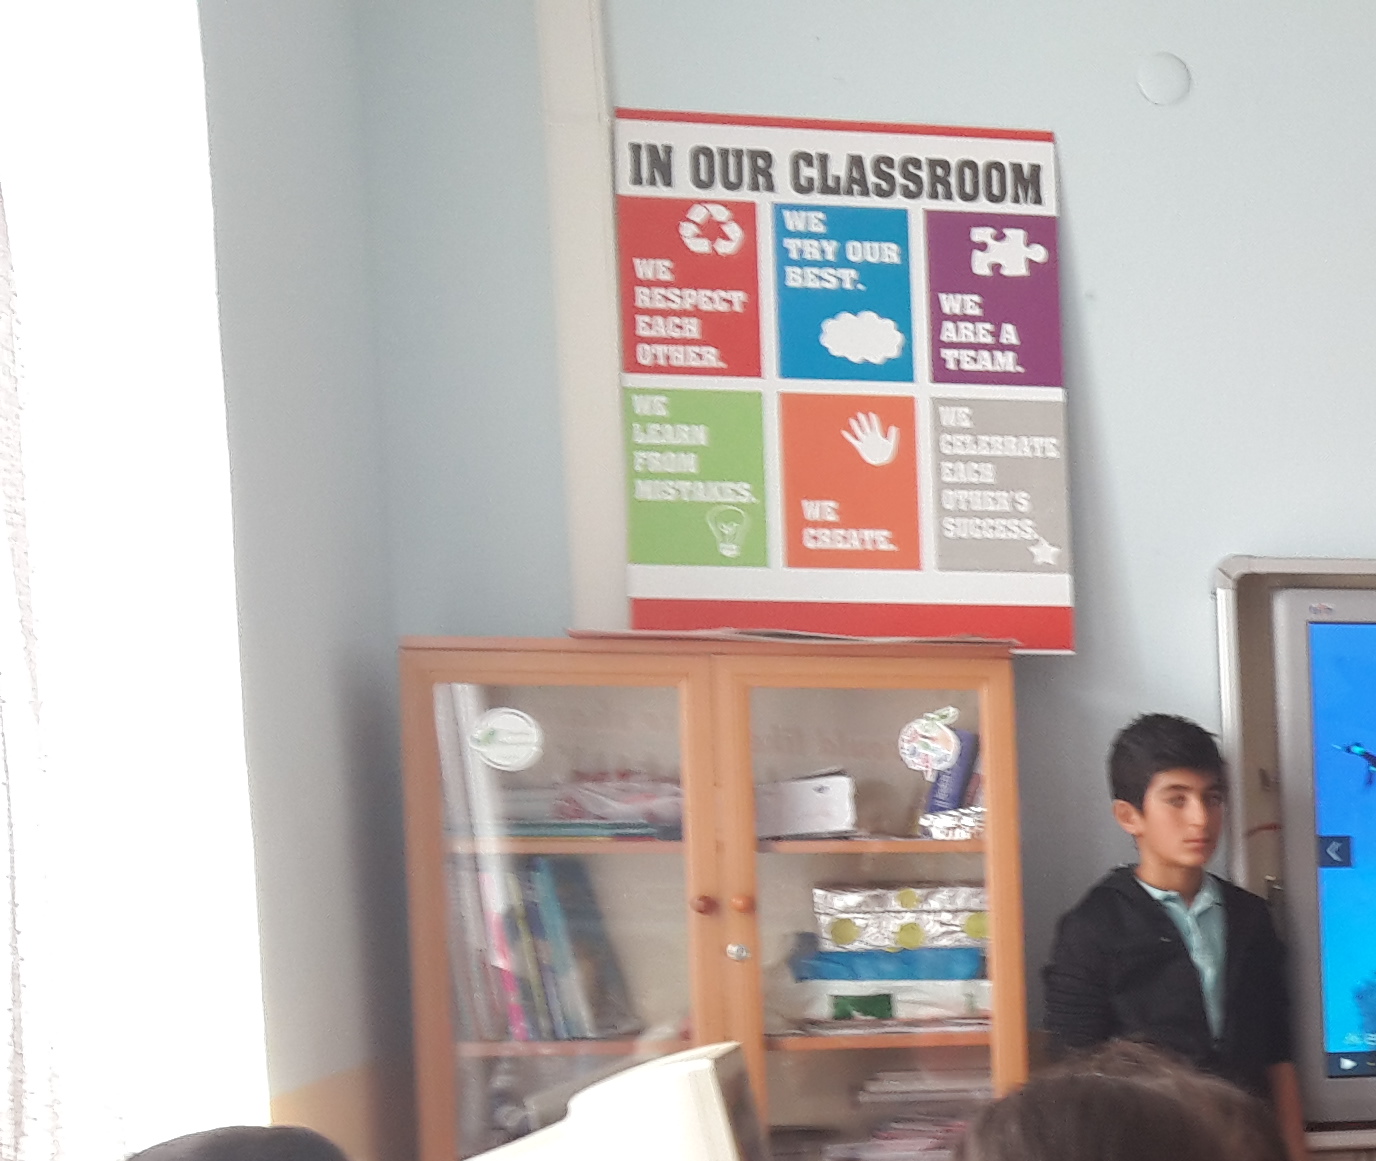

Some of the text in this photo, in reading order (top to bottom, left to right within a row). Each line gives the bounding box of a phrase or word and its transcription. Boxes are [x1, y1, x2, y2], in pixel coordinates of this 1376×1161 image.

[628, 142, 1044, 206] IN OUR CLASSROOM
[783, 209, 826, 235] WE
[785, 238, 901, 265] TRY OUR
[632, 258, 675, 283] WE
[785, 268, 866, 291] BEST.
[634, 287, 748, 313] RESPECT
[939, 292, 983, 317] WE
[634, 315, 701, 340] EACH
[940, 322, 1021, 346] ARE A
[635, 344, 728, 369] OTHER.
[941, 348, 1025, 374] TEAM.
[631, 395, 669, 418] WE
[939, 406, 974, 429] WE
[632, 423, 709, 447] LEARN
[939, 435, 1060, 459] CELEBRATE
[632, 451, 699, 474] FROM
[939, 462, 996, 484] EACH
[802, 499, 838, 524] WE
